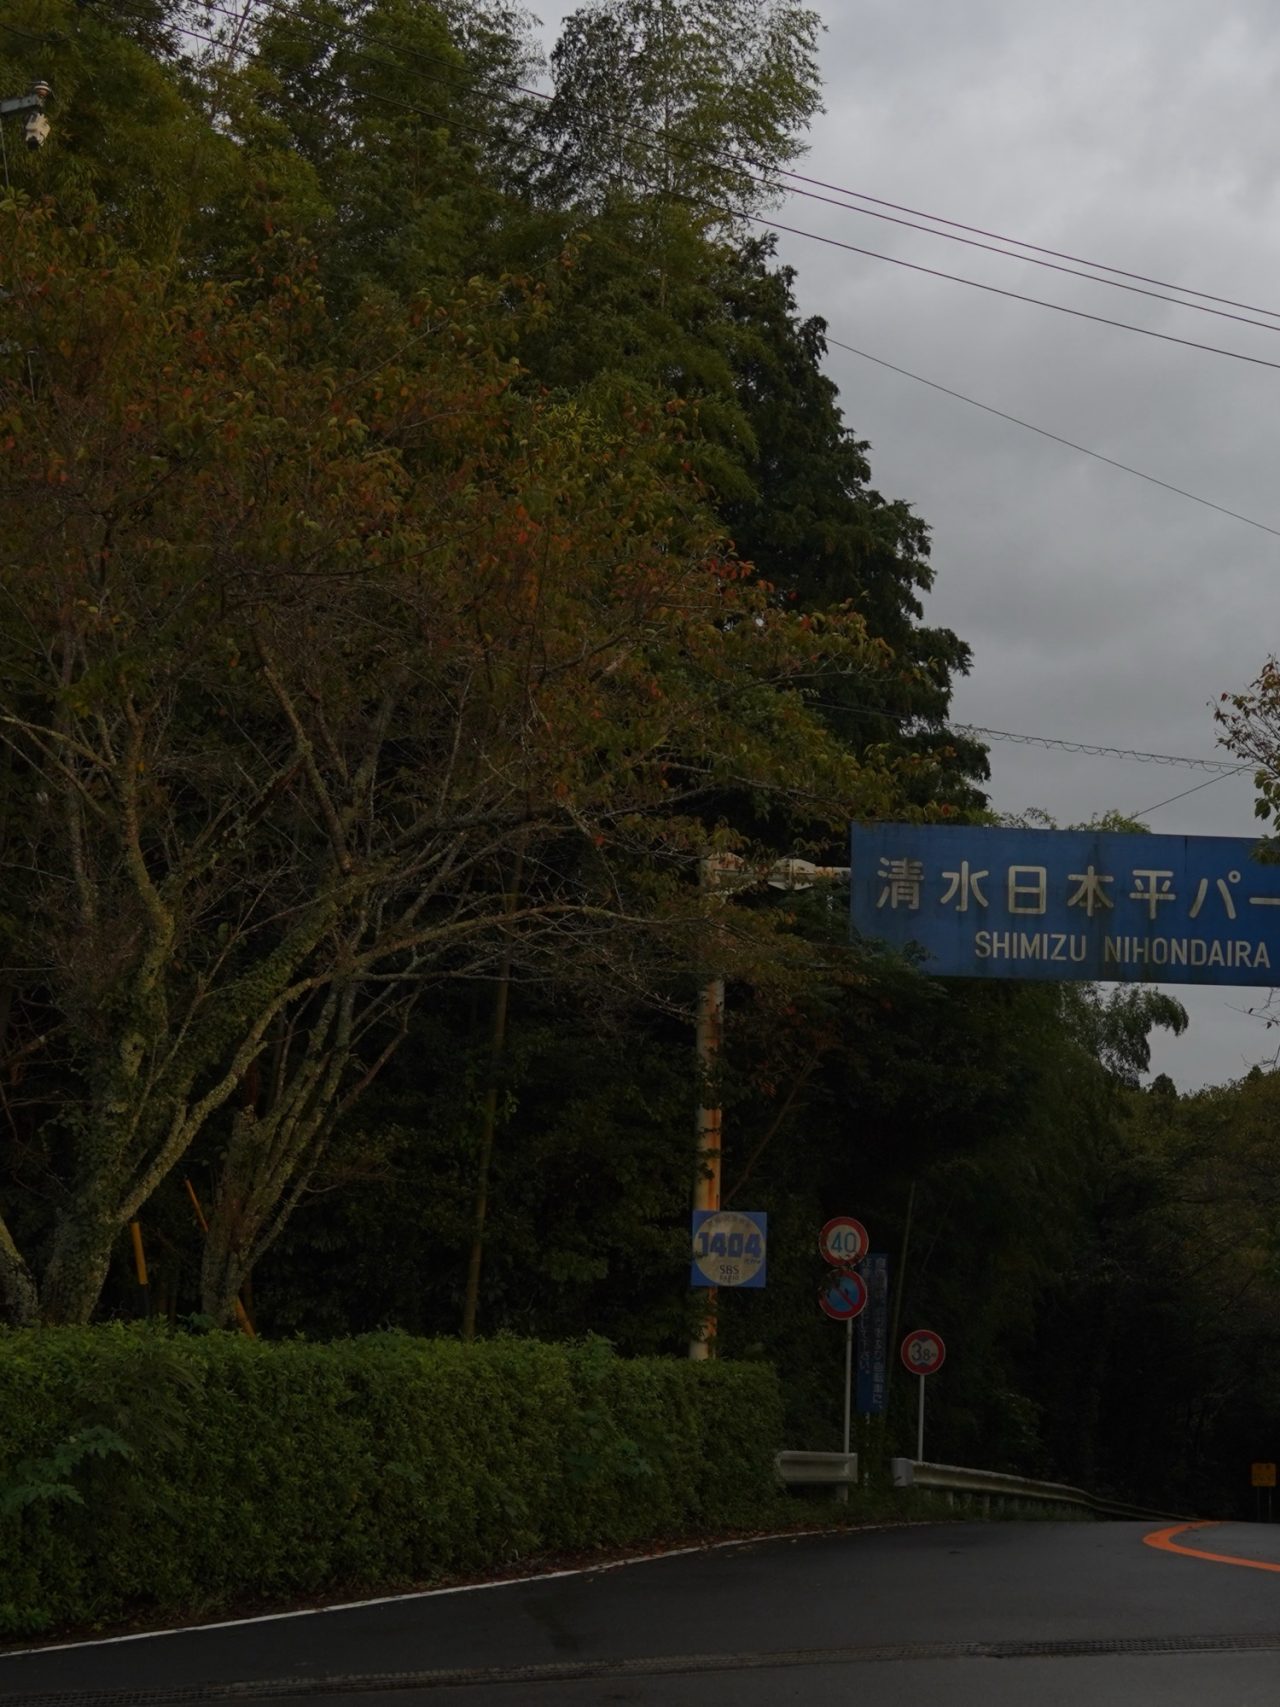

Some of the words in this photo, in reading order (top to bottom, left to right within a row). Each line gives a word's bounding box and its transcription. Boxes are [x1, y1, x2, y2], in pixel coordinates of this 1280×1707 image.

[975, 930, 1087, 962] SHIMIZU
[1104, 935, 1270, 969] NIHONDAIRA
[698, 1232, 761, 1258] 1404
[831, 1232, 857, 1252] 40
[719, 1264, 740, 1275] SBS
